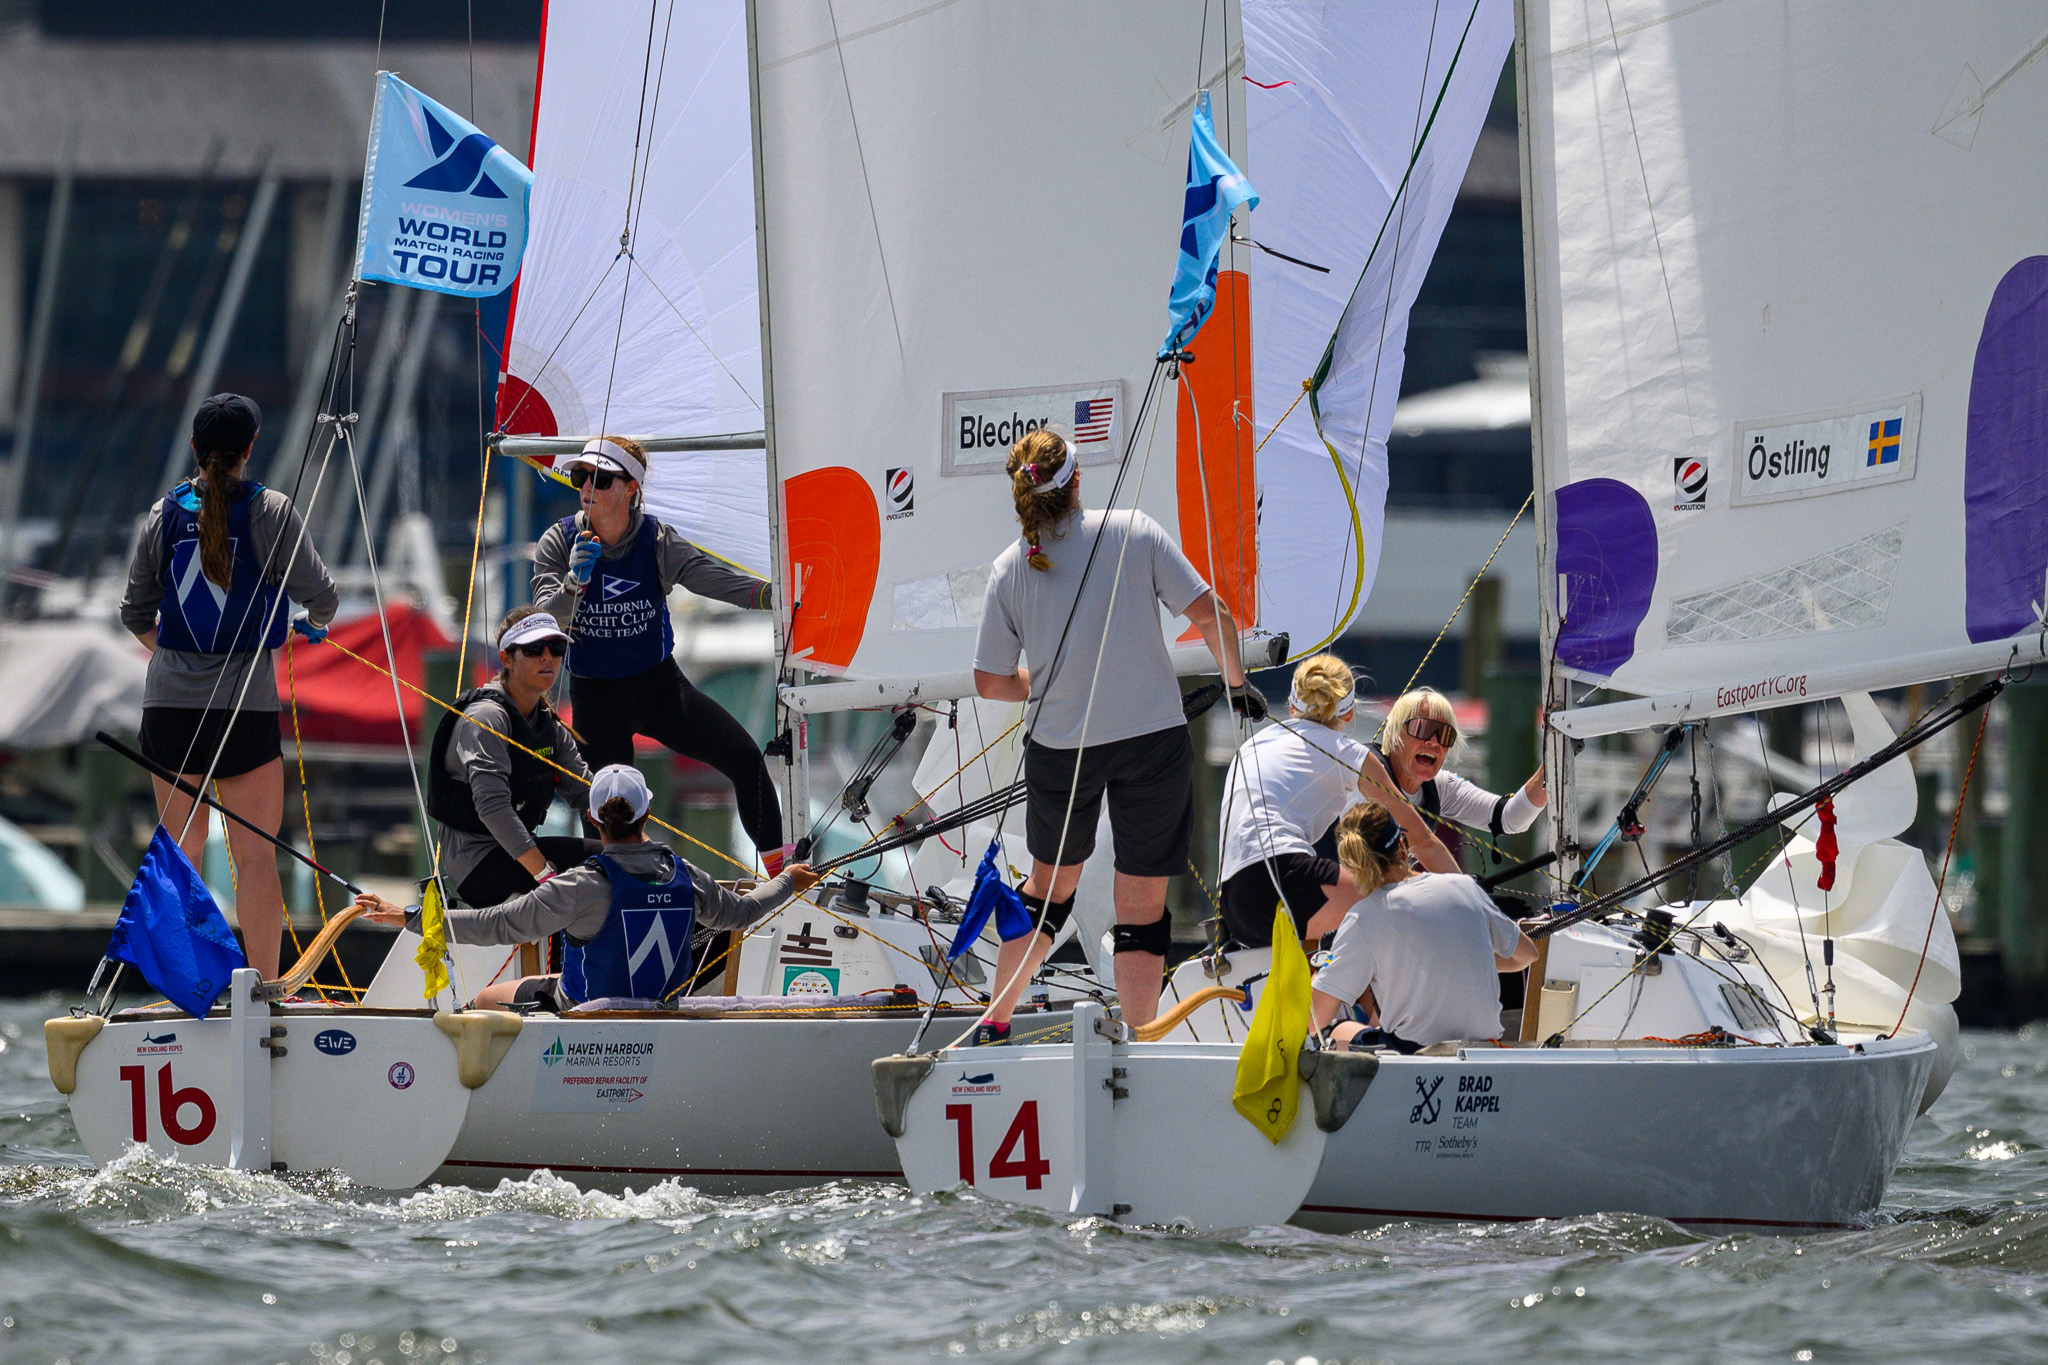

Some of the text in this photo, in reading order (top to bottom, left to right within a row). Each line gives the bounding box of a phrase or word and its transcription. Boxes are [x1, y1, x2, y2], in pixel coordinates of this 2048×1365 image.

[401, 202, 508, 228] WOMEN'S
[398, 217, 507, 248] WORLD
[394, 237, 505, 261] MATCH RACING
[393, 250, 502, 286] TOUR
[1748, 436, 1831, 481] Östling
[577, 599, 653, 614] CALIFORNIA
[574, 613, 618, 627] YACHT
[620, 608, 656, 626] CLUB
[580, 622, 648, 638] RACE TEAM
[1717, 675, 1807, 708] EastportYC.org
[647, 893, 672, 903] CYC
[319, 1036, 352, 1049] EWE
[567, 1043, 654, 1055] HAVEN HARBOUR
[566, 1056, 641, 1067] MARINA RESORTS
[563, 1076, 648, 1085] PREFERRED REPAIR FACILITY OF
[1458, 1076, 1493, 1092] BRAD
[597, 1088, 630, 1098] EASTPORT
[120, 1061, 217, 1146] 16
[1455, 1096, 1500, 1112] KAPPEL
[1453, 1117, 1478, 1129] TEAM
[946, 1100, 1050, 1190] 14
[1415, 1135, 1478, 1153] TTR Sotheby's
